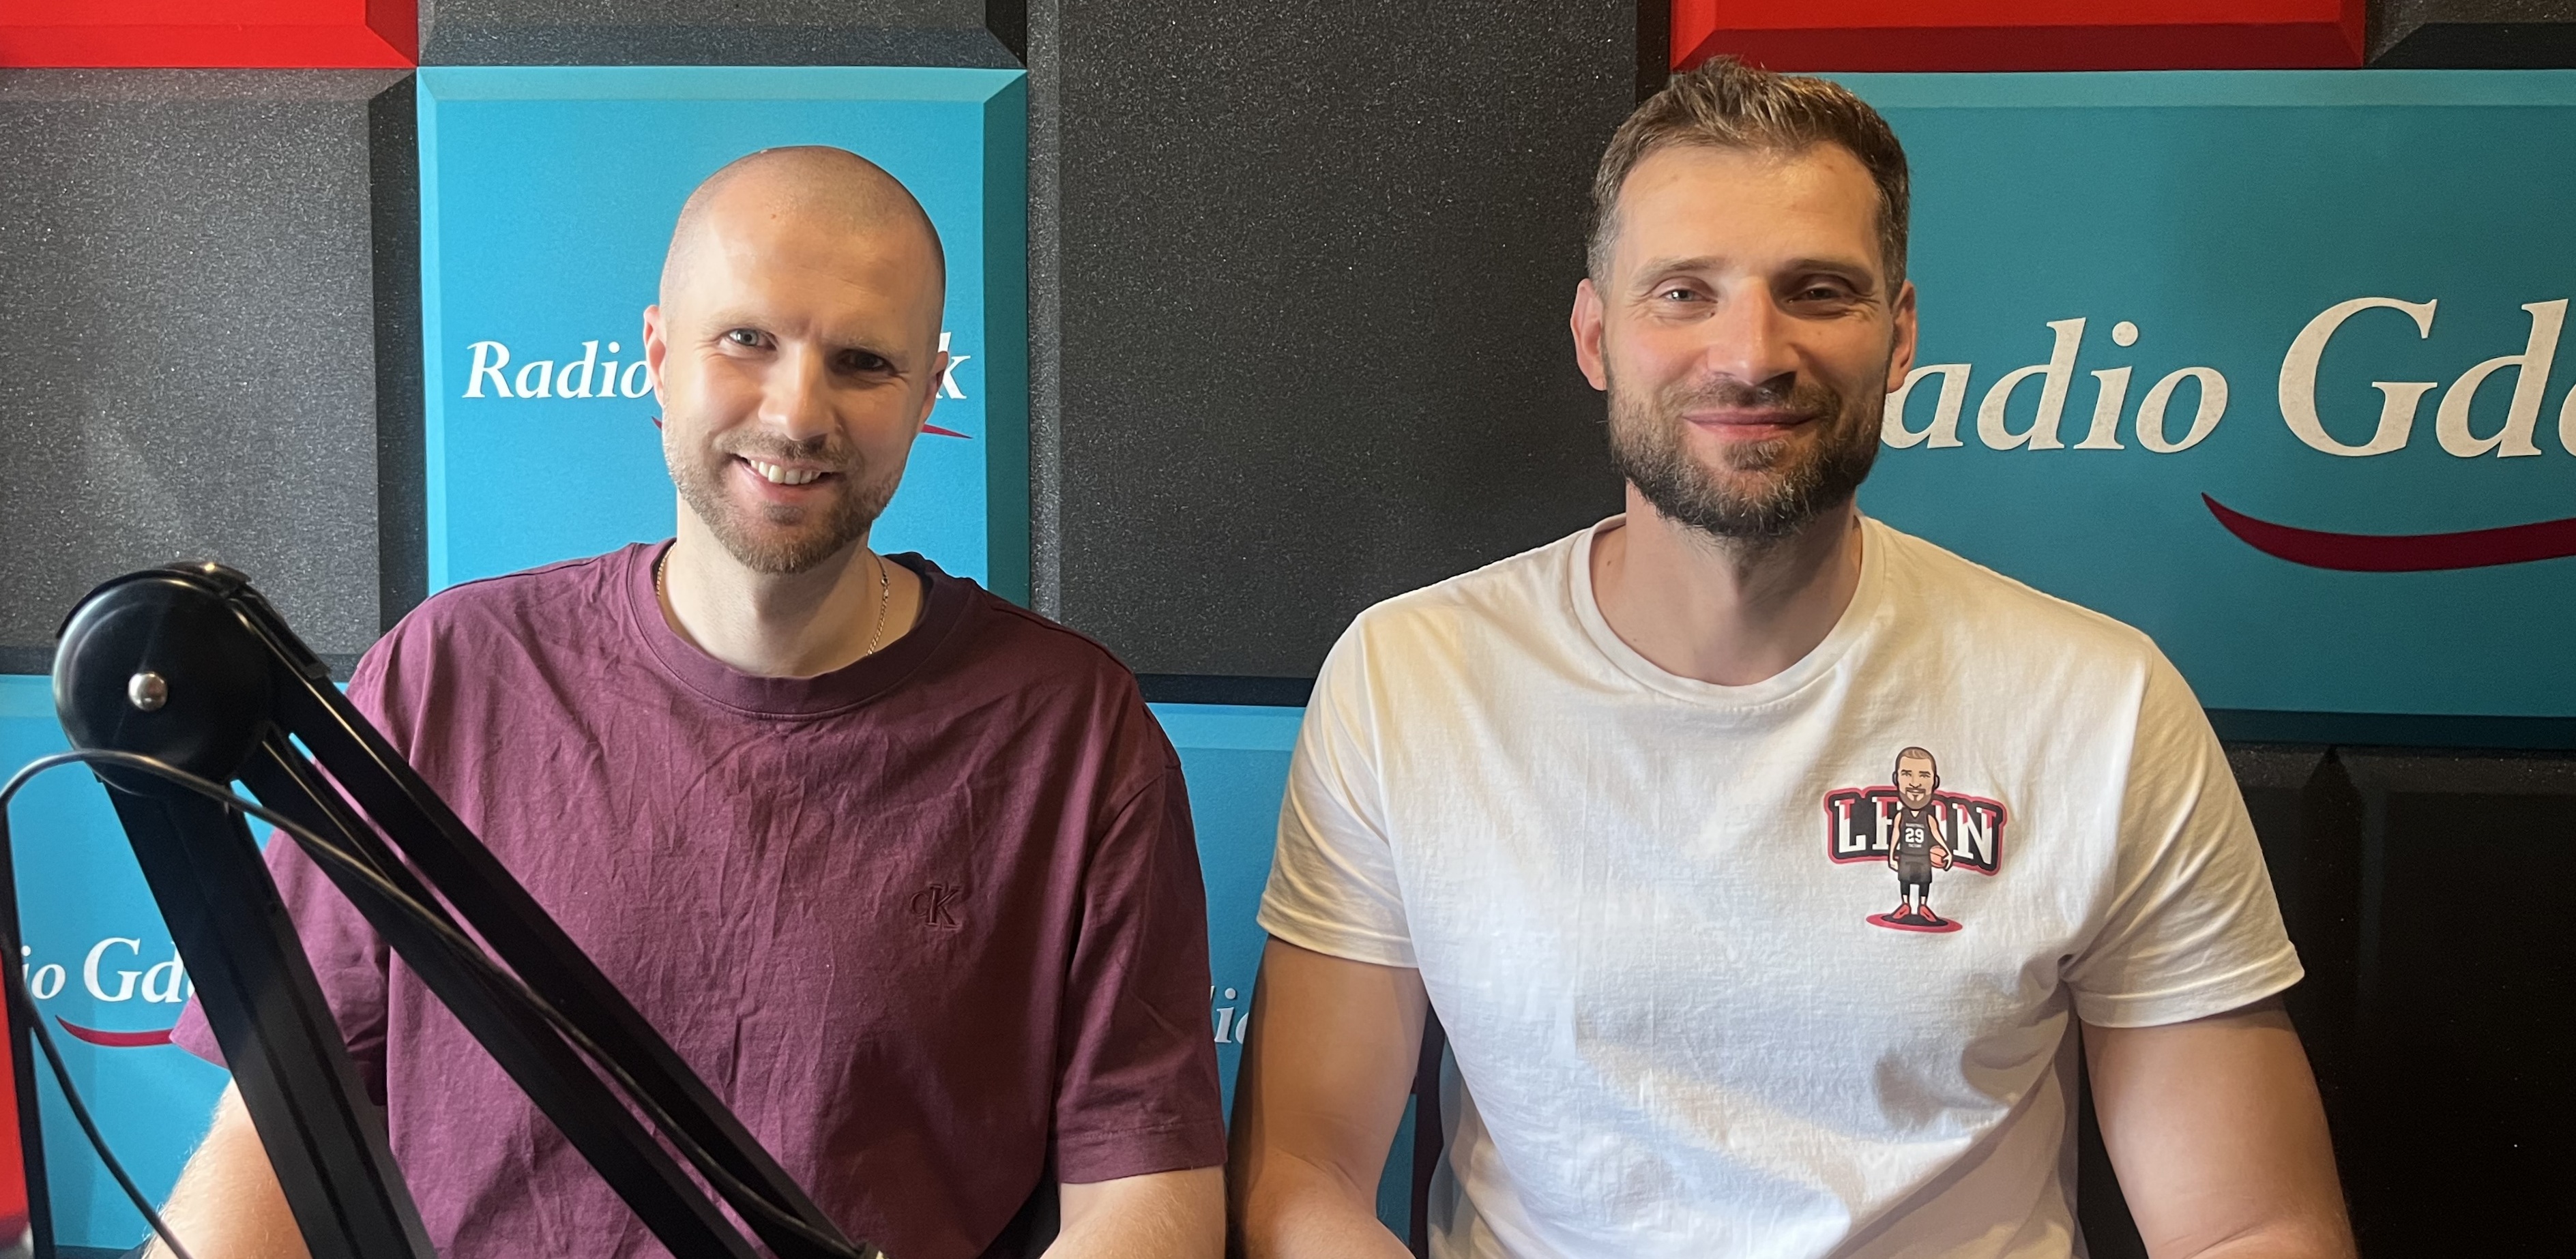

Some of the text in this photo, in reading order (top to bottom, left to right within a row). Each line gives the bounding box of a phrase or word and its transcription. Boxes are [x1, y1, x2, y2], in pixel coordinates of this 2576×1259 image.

[462, 340, 654, 399] Radio
[1879, 297, 2576, 458] adio Gd
[1834, 796, 1997, 865] LEN
[1905, 827, 1924, 844] 29
[83, 937, 195, 1003] Gd
